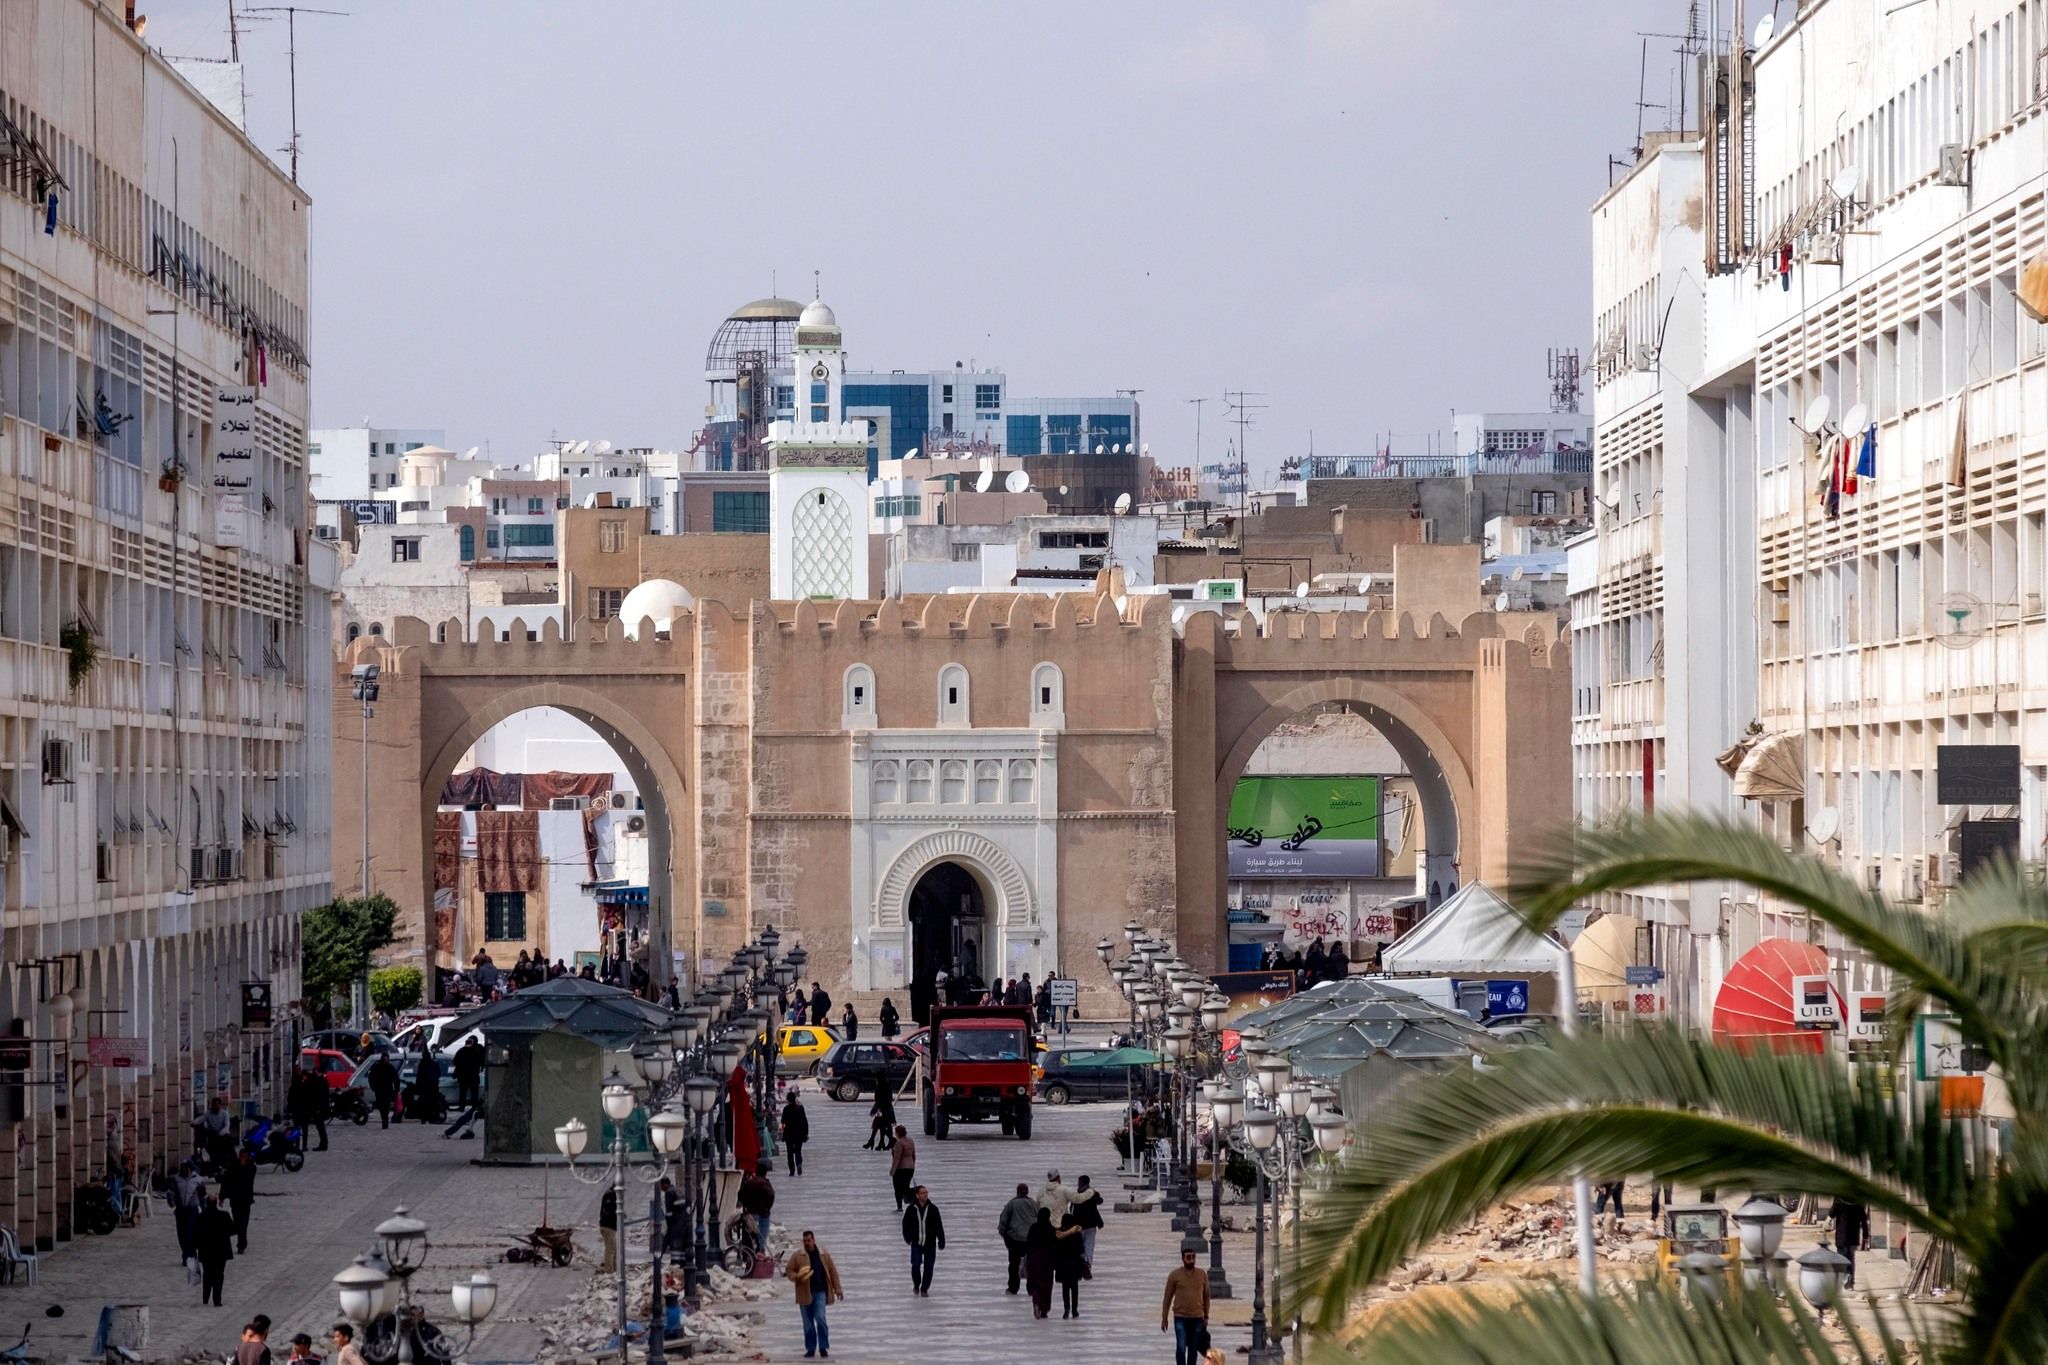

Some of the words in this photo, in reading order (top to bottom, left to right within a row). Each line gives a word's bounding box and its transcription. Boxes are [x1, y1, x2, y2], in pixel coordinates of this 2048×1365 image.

[218, 390, 253, 406] مدرسة
[220, 419, 250, 435] نجلاء
[217, 448, 252, 463] لتعليم
[213, 474, 252, 491] السياقة
[1280, 814, 1323, 851] خطوة
[1267, 857, 1285, 867] طريق
[1801, 1006, 1834, 1018] UIB
[1856, 1025, 1890, 1036] UIB
